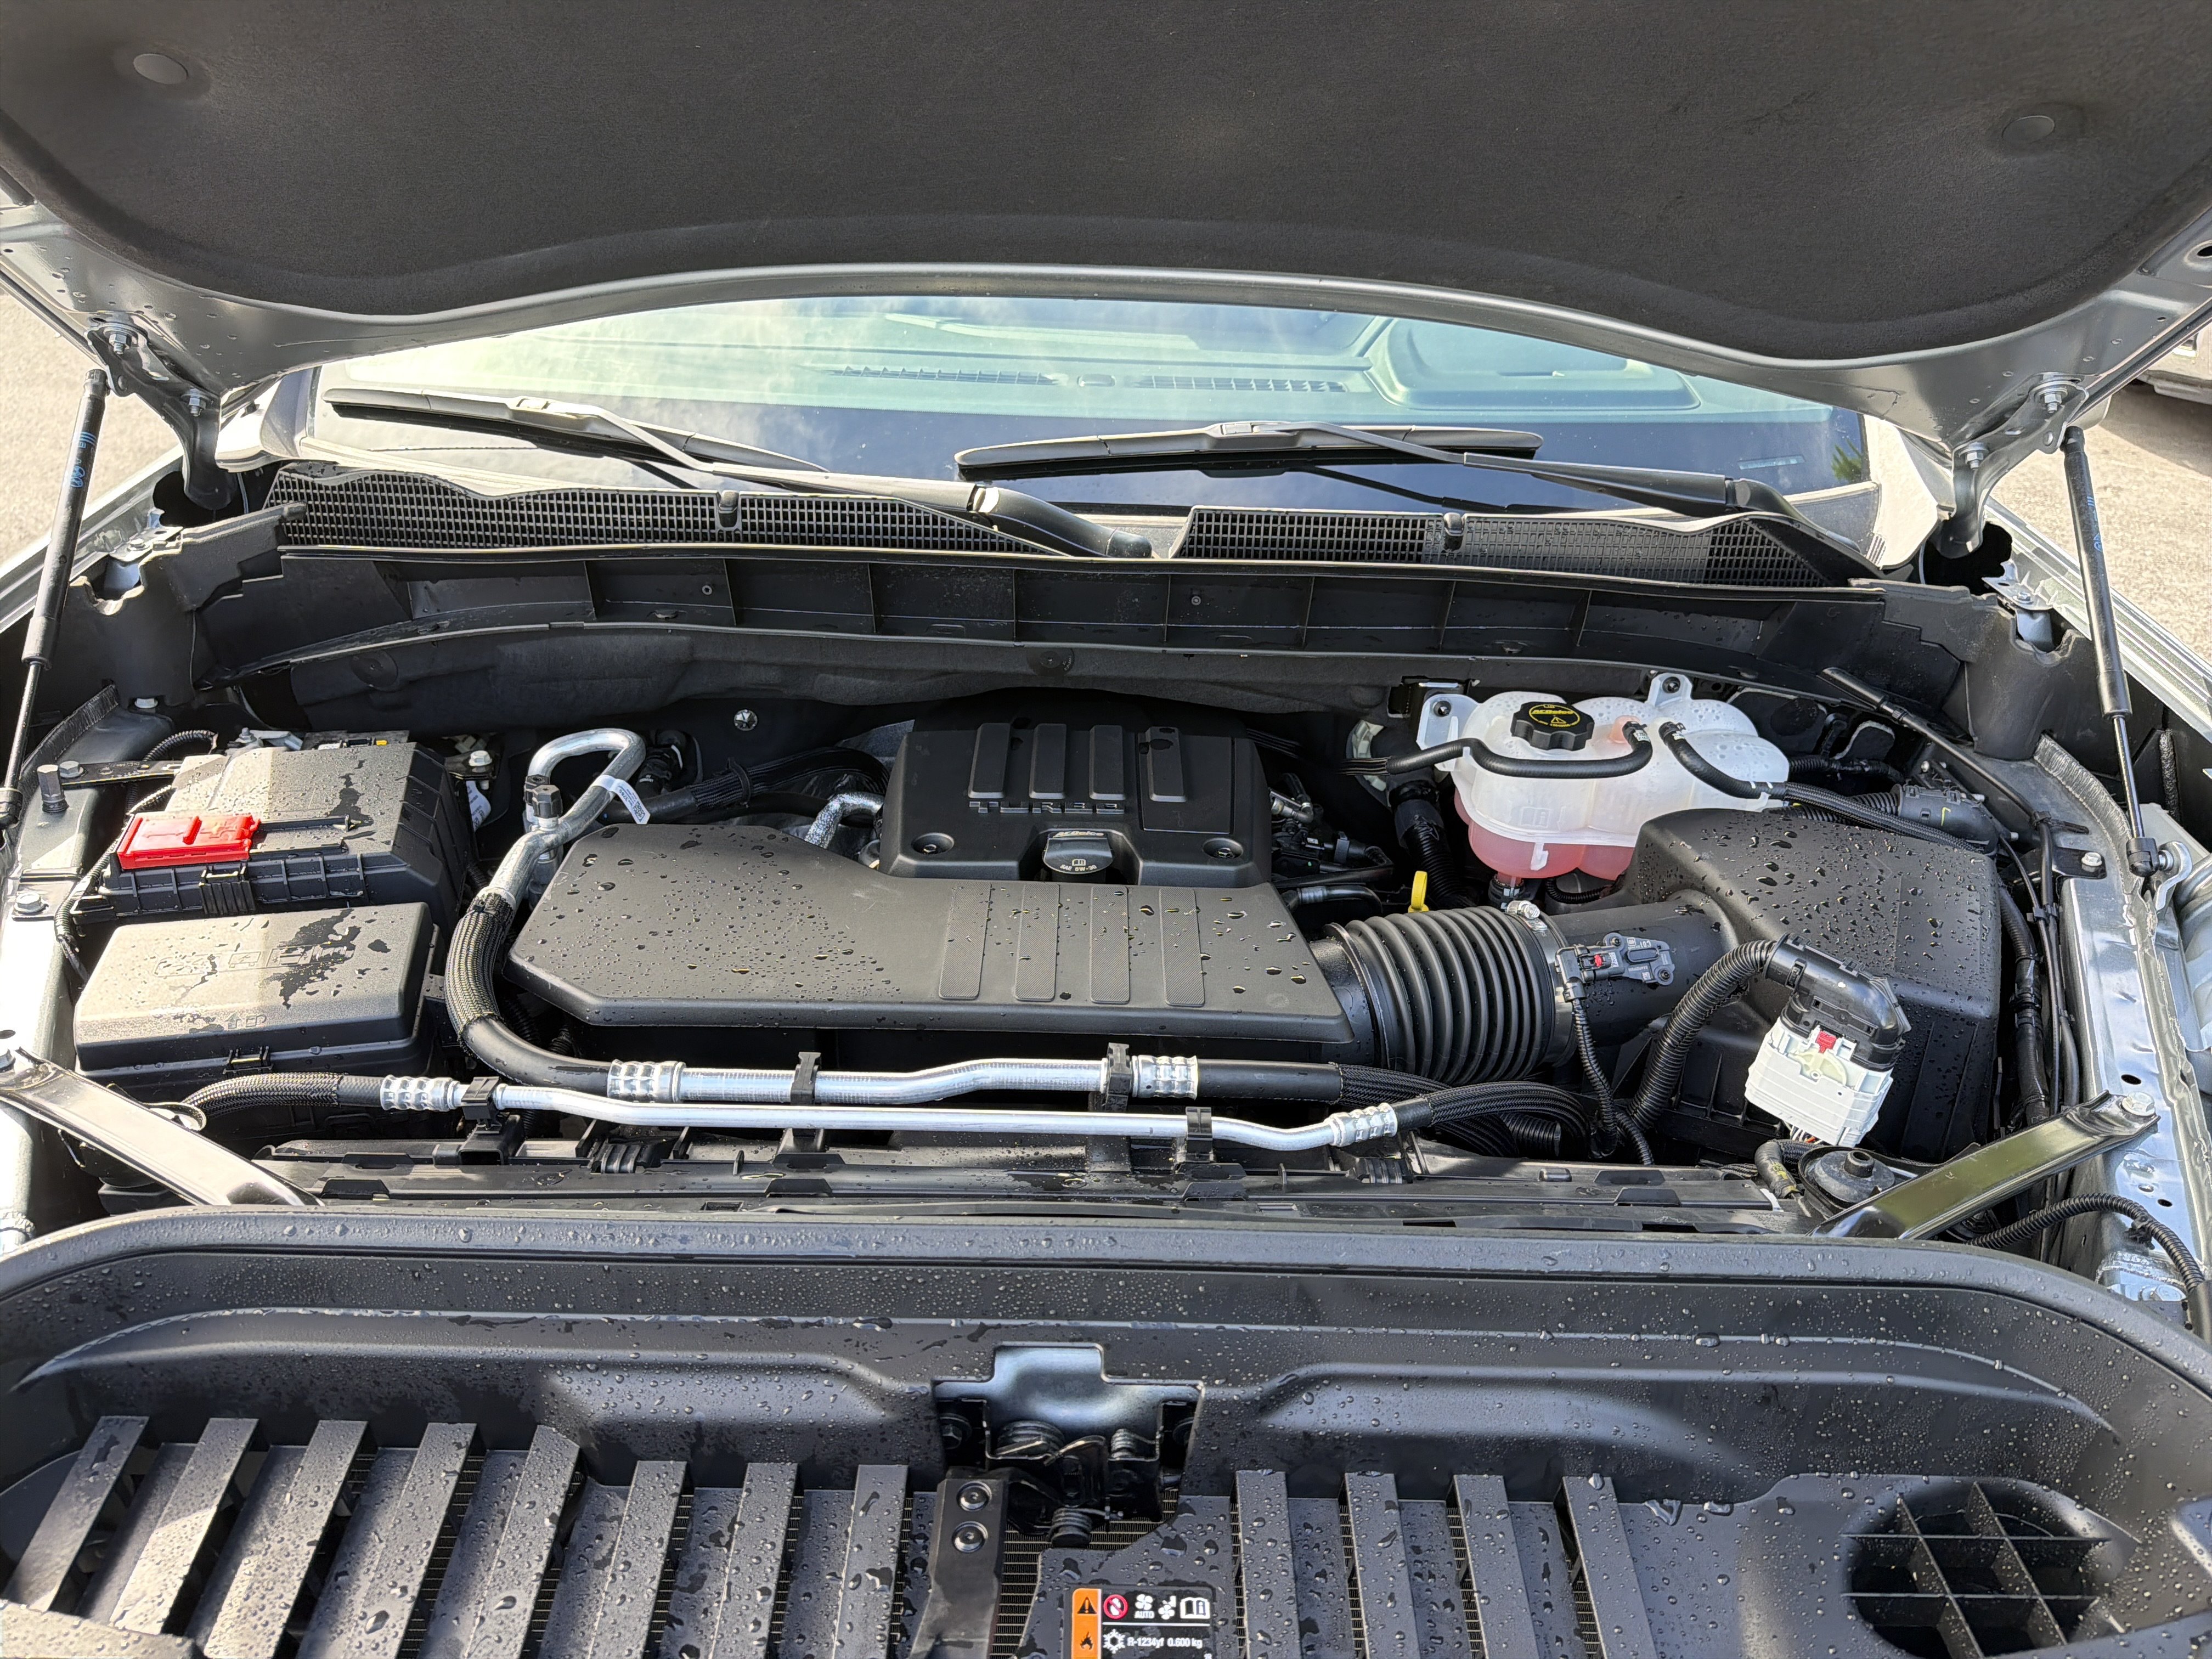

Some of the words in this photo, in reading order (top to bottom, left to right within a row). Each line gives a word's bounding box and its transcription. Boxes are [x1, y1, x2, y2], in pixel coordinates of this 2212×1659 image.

[969, 801, 1125, 815] TURBO
[1133, 1610, 1155, 1619] AUTO
[1127, 1637, 1164, 1649] R-1234yf
[1167, 1637, 1190, 1647] 0.600
[1192, 1638, 1203, 1649] kg
